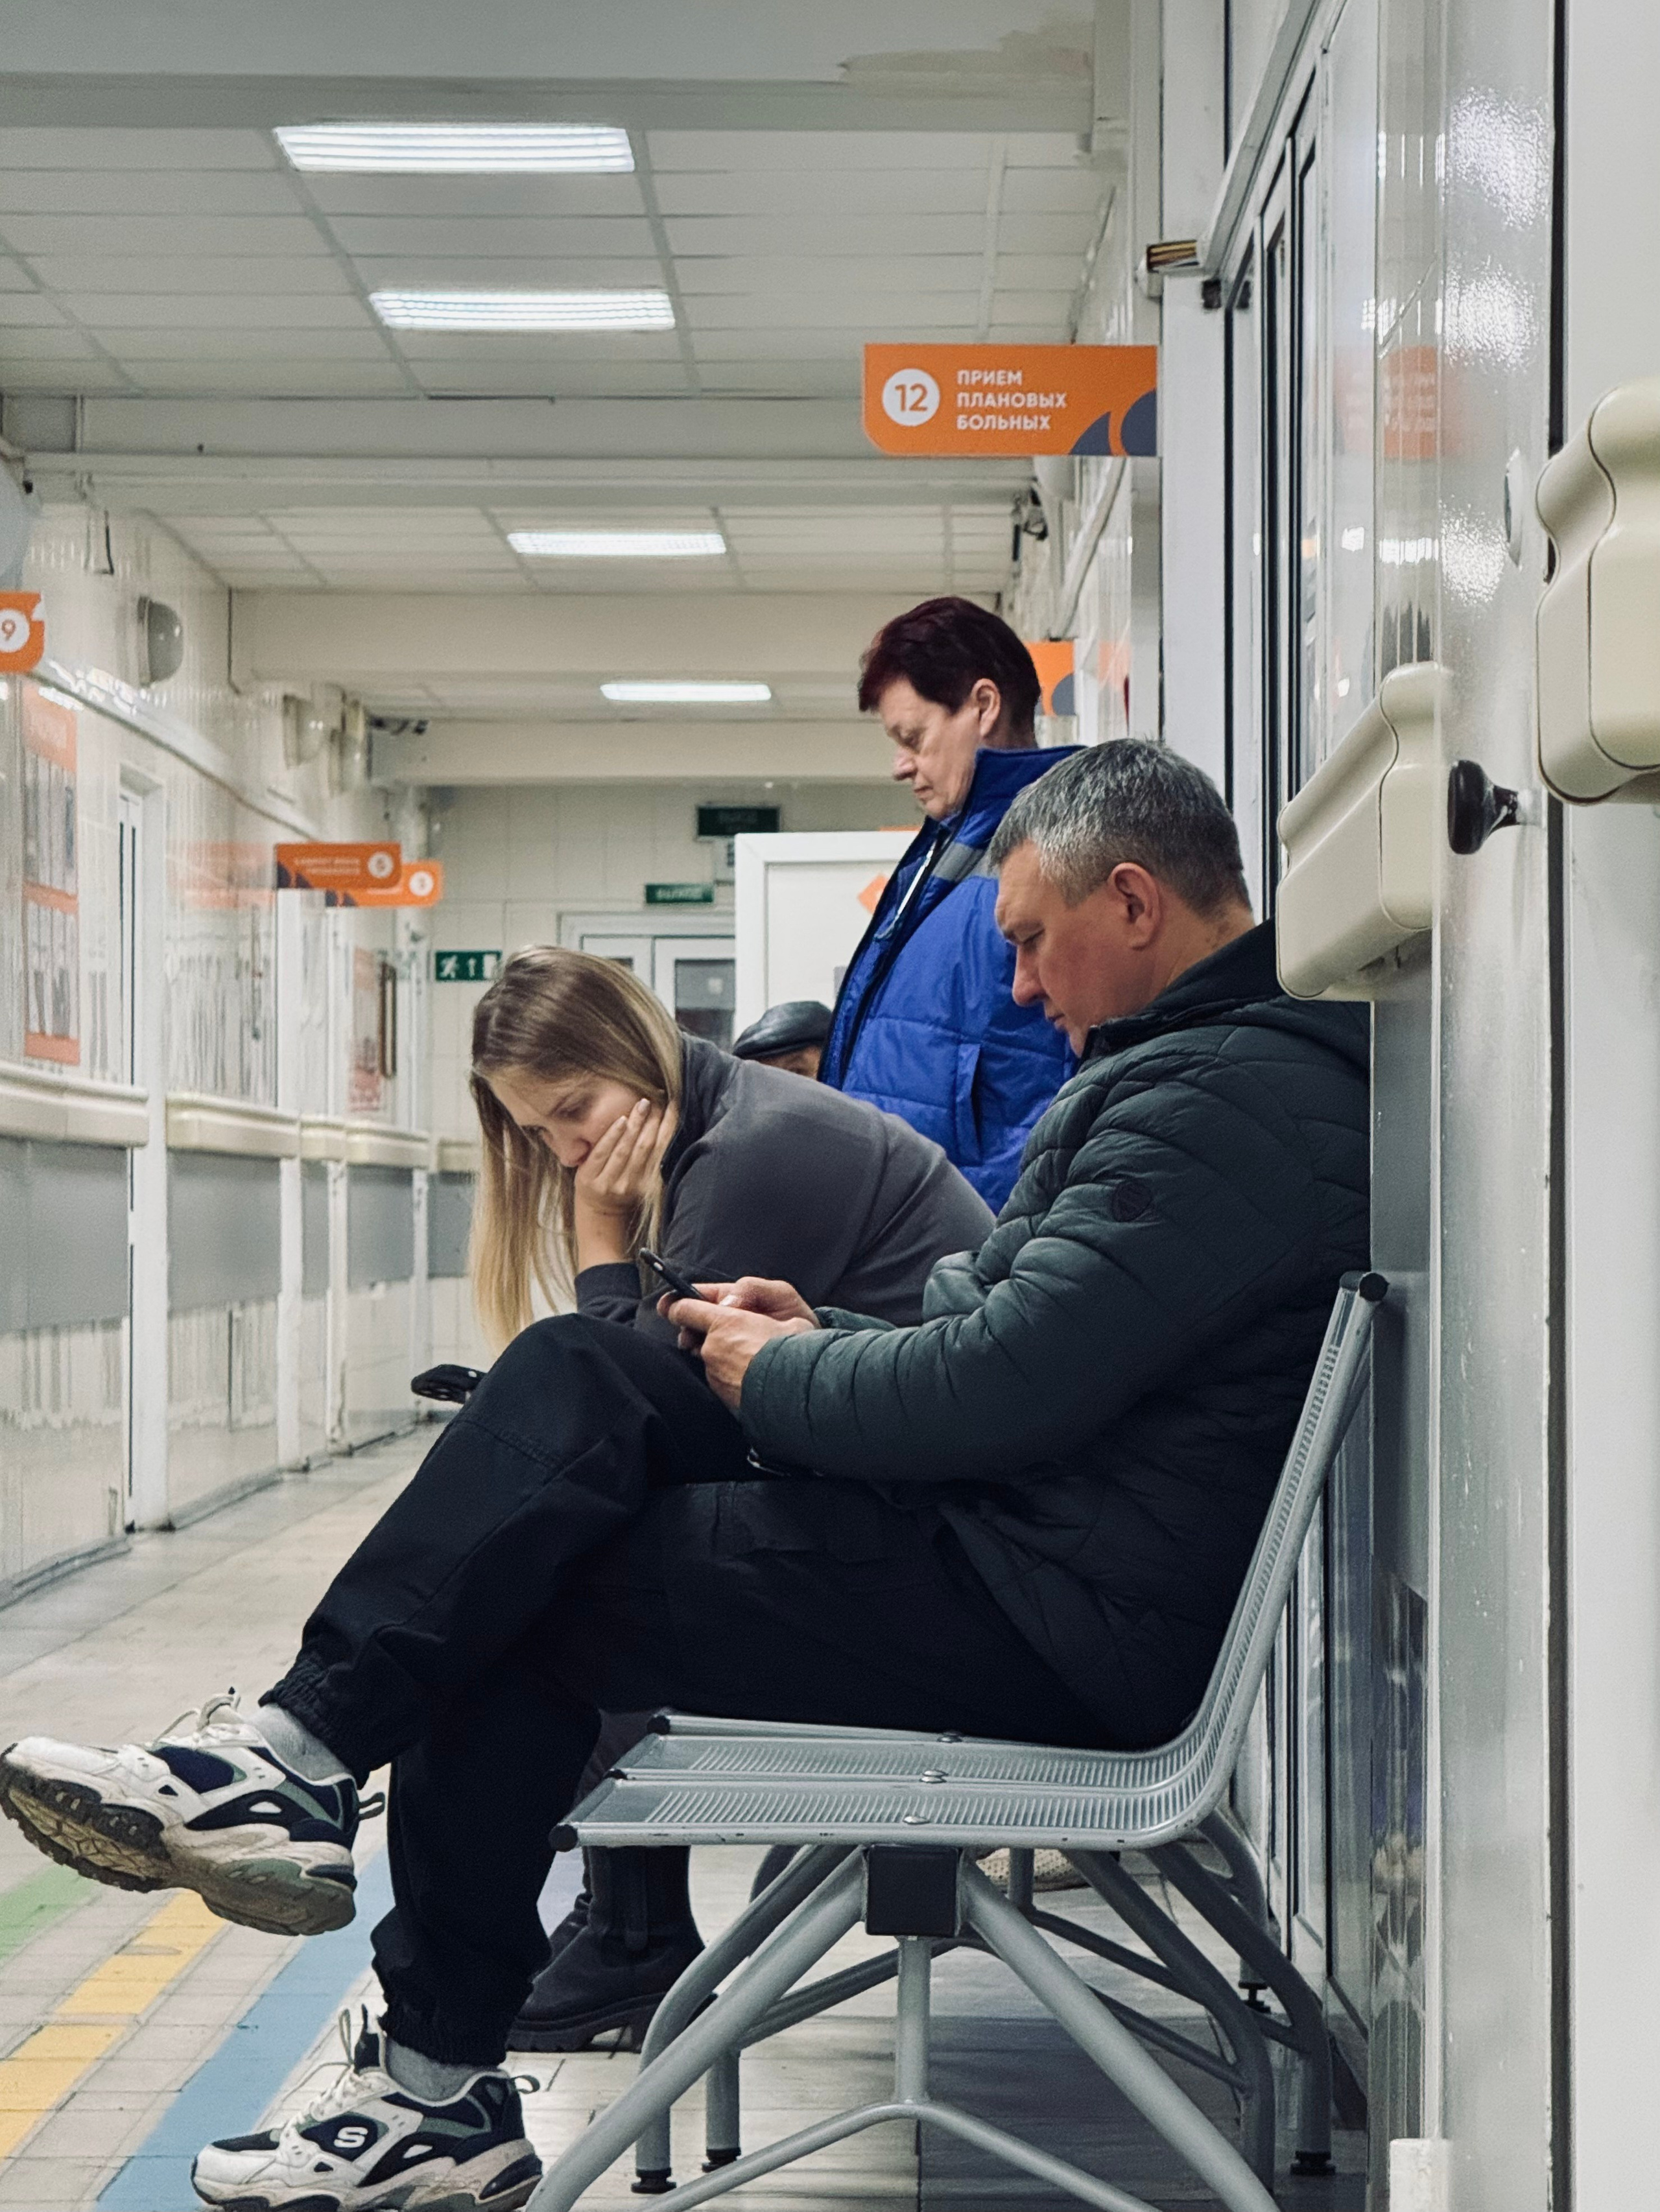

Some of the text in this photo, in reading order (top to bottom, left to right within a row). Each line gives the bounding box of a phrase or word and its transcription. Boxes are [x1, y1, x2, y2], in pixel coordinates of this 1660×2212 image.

[957, 370, 1023, 385] ПРИЕМ
[895, 384, 928, 412] 12
[957, 392, 1067, 408] ПЛАНОВЫХ
[957, 415, 1050, 430] БОЛЬНЫХ
[1, 619, 16, 641] 9
[334, 2127, 368, 2148] S
